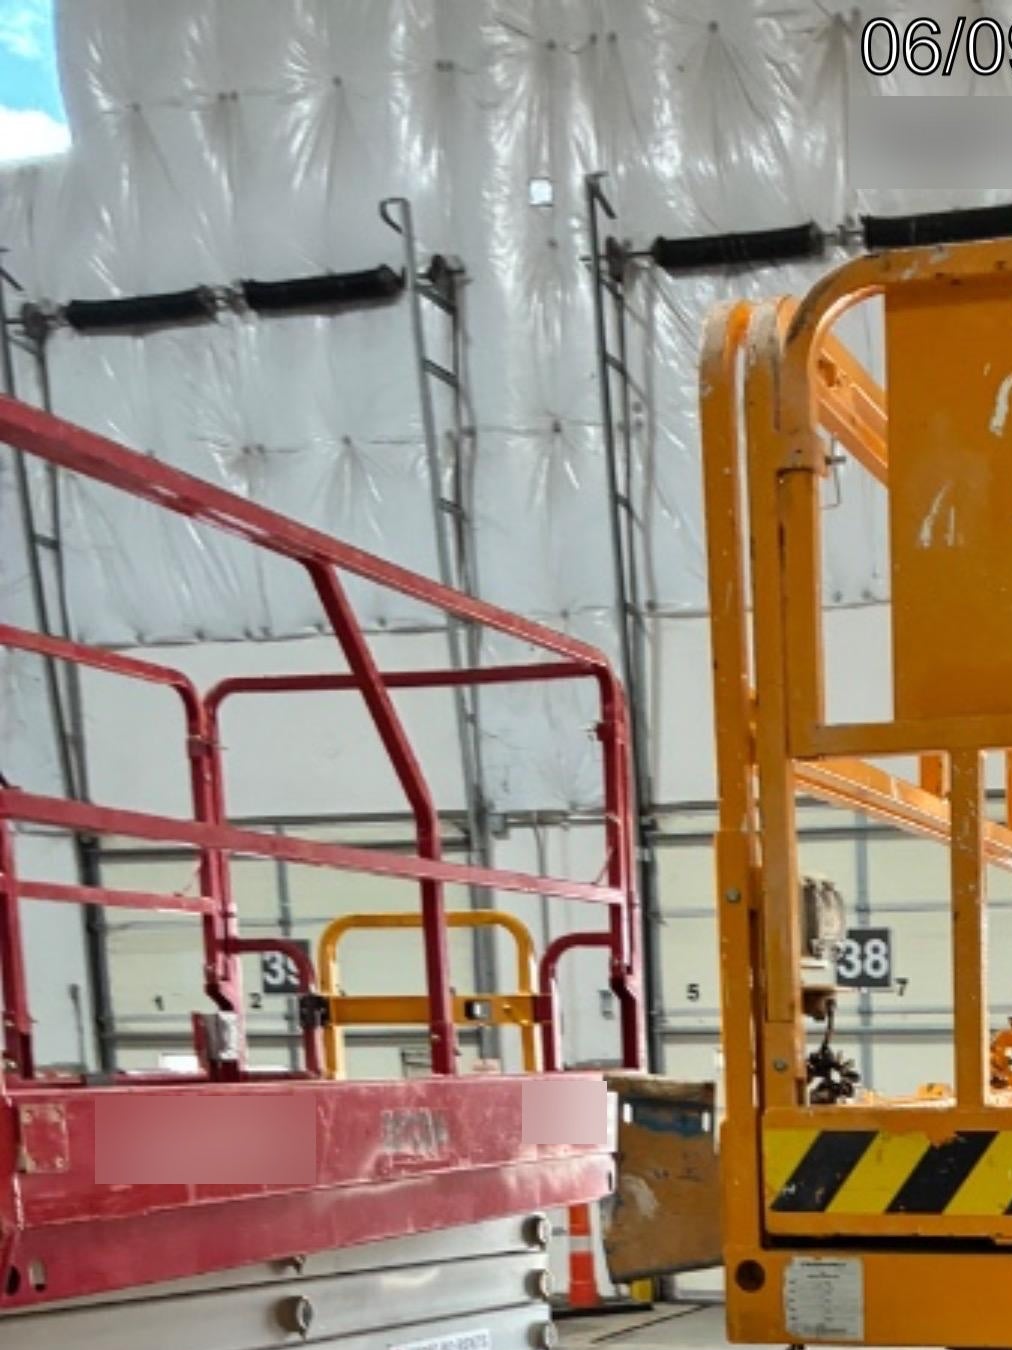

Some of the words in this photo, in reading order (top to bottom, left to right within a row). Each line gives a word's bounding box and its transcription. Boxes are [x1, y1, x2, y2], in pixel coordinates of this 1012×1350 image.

[839, 938, 888, 978] 38
[686, 983, 700, 1001] 5
[895, 977, 909, 996] 7
[250, 992, 261, 1009] 2
